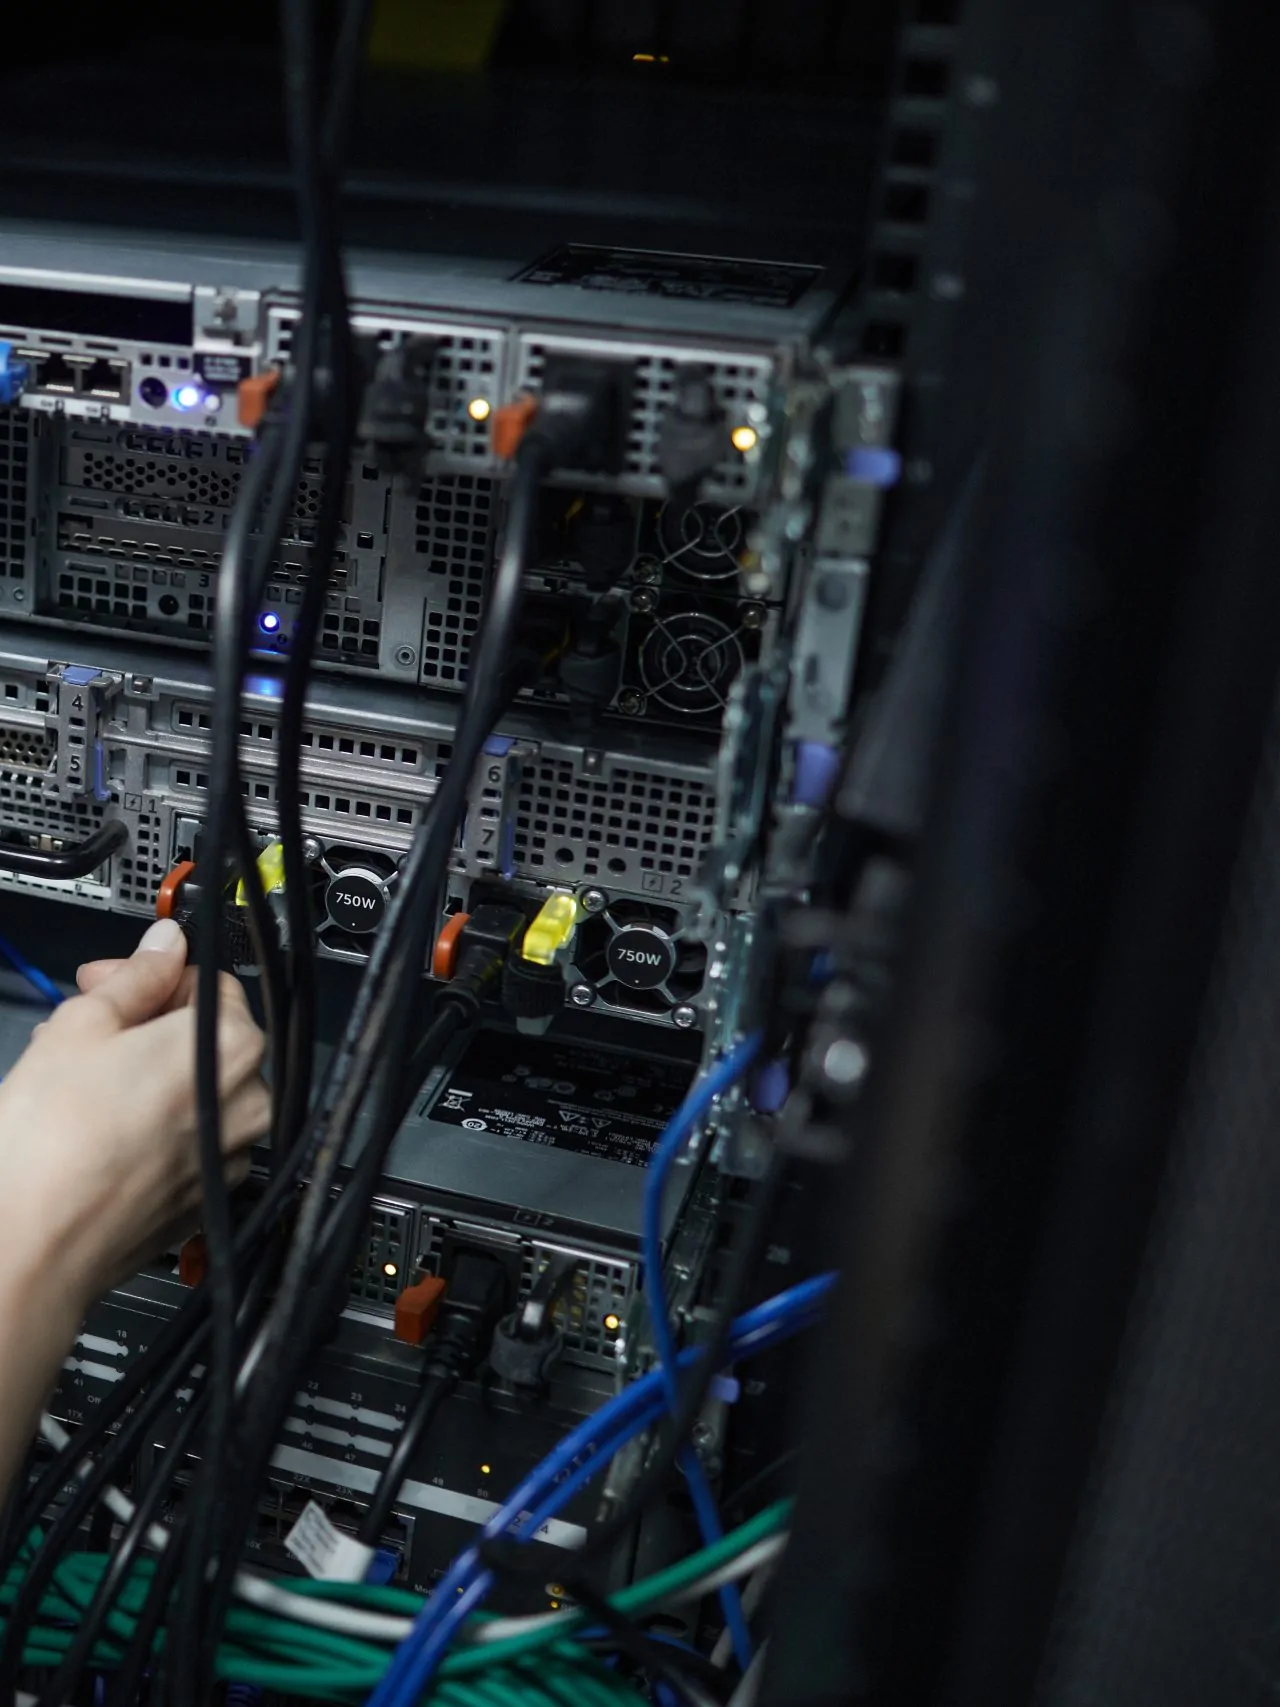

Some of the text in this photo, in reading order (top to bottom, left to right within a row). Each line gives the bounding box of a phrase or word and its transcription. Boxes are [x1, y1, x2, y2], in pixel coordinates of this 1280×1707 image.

[210, 442, 219, 458] 1
[202, 509, 215, 526] 2
[198, 573, 210, 589] 3
[70, 693, 84, 712] 4
[69, 754, 81, 772] 5
[487, 764, 502, 783] 6
[147, 798, 158, 814] 1
[481, 828, 495, 846] 7
[670, 879, 683, 896] 2
[335, 891, 377, 911] 750W
[617, 947, 662, 967] 750W
[349, 1391, 363, 1402] 23
[344, 1451, 357, 1462] 47
